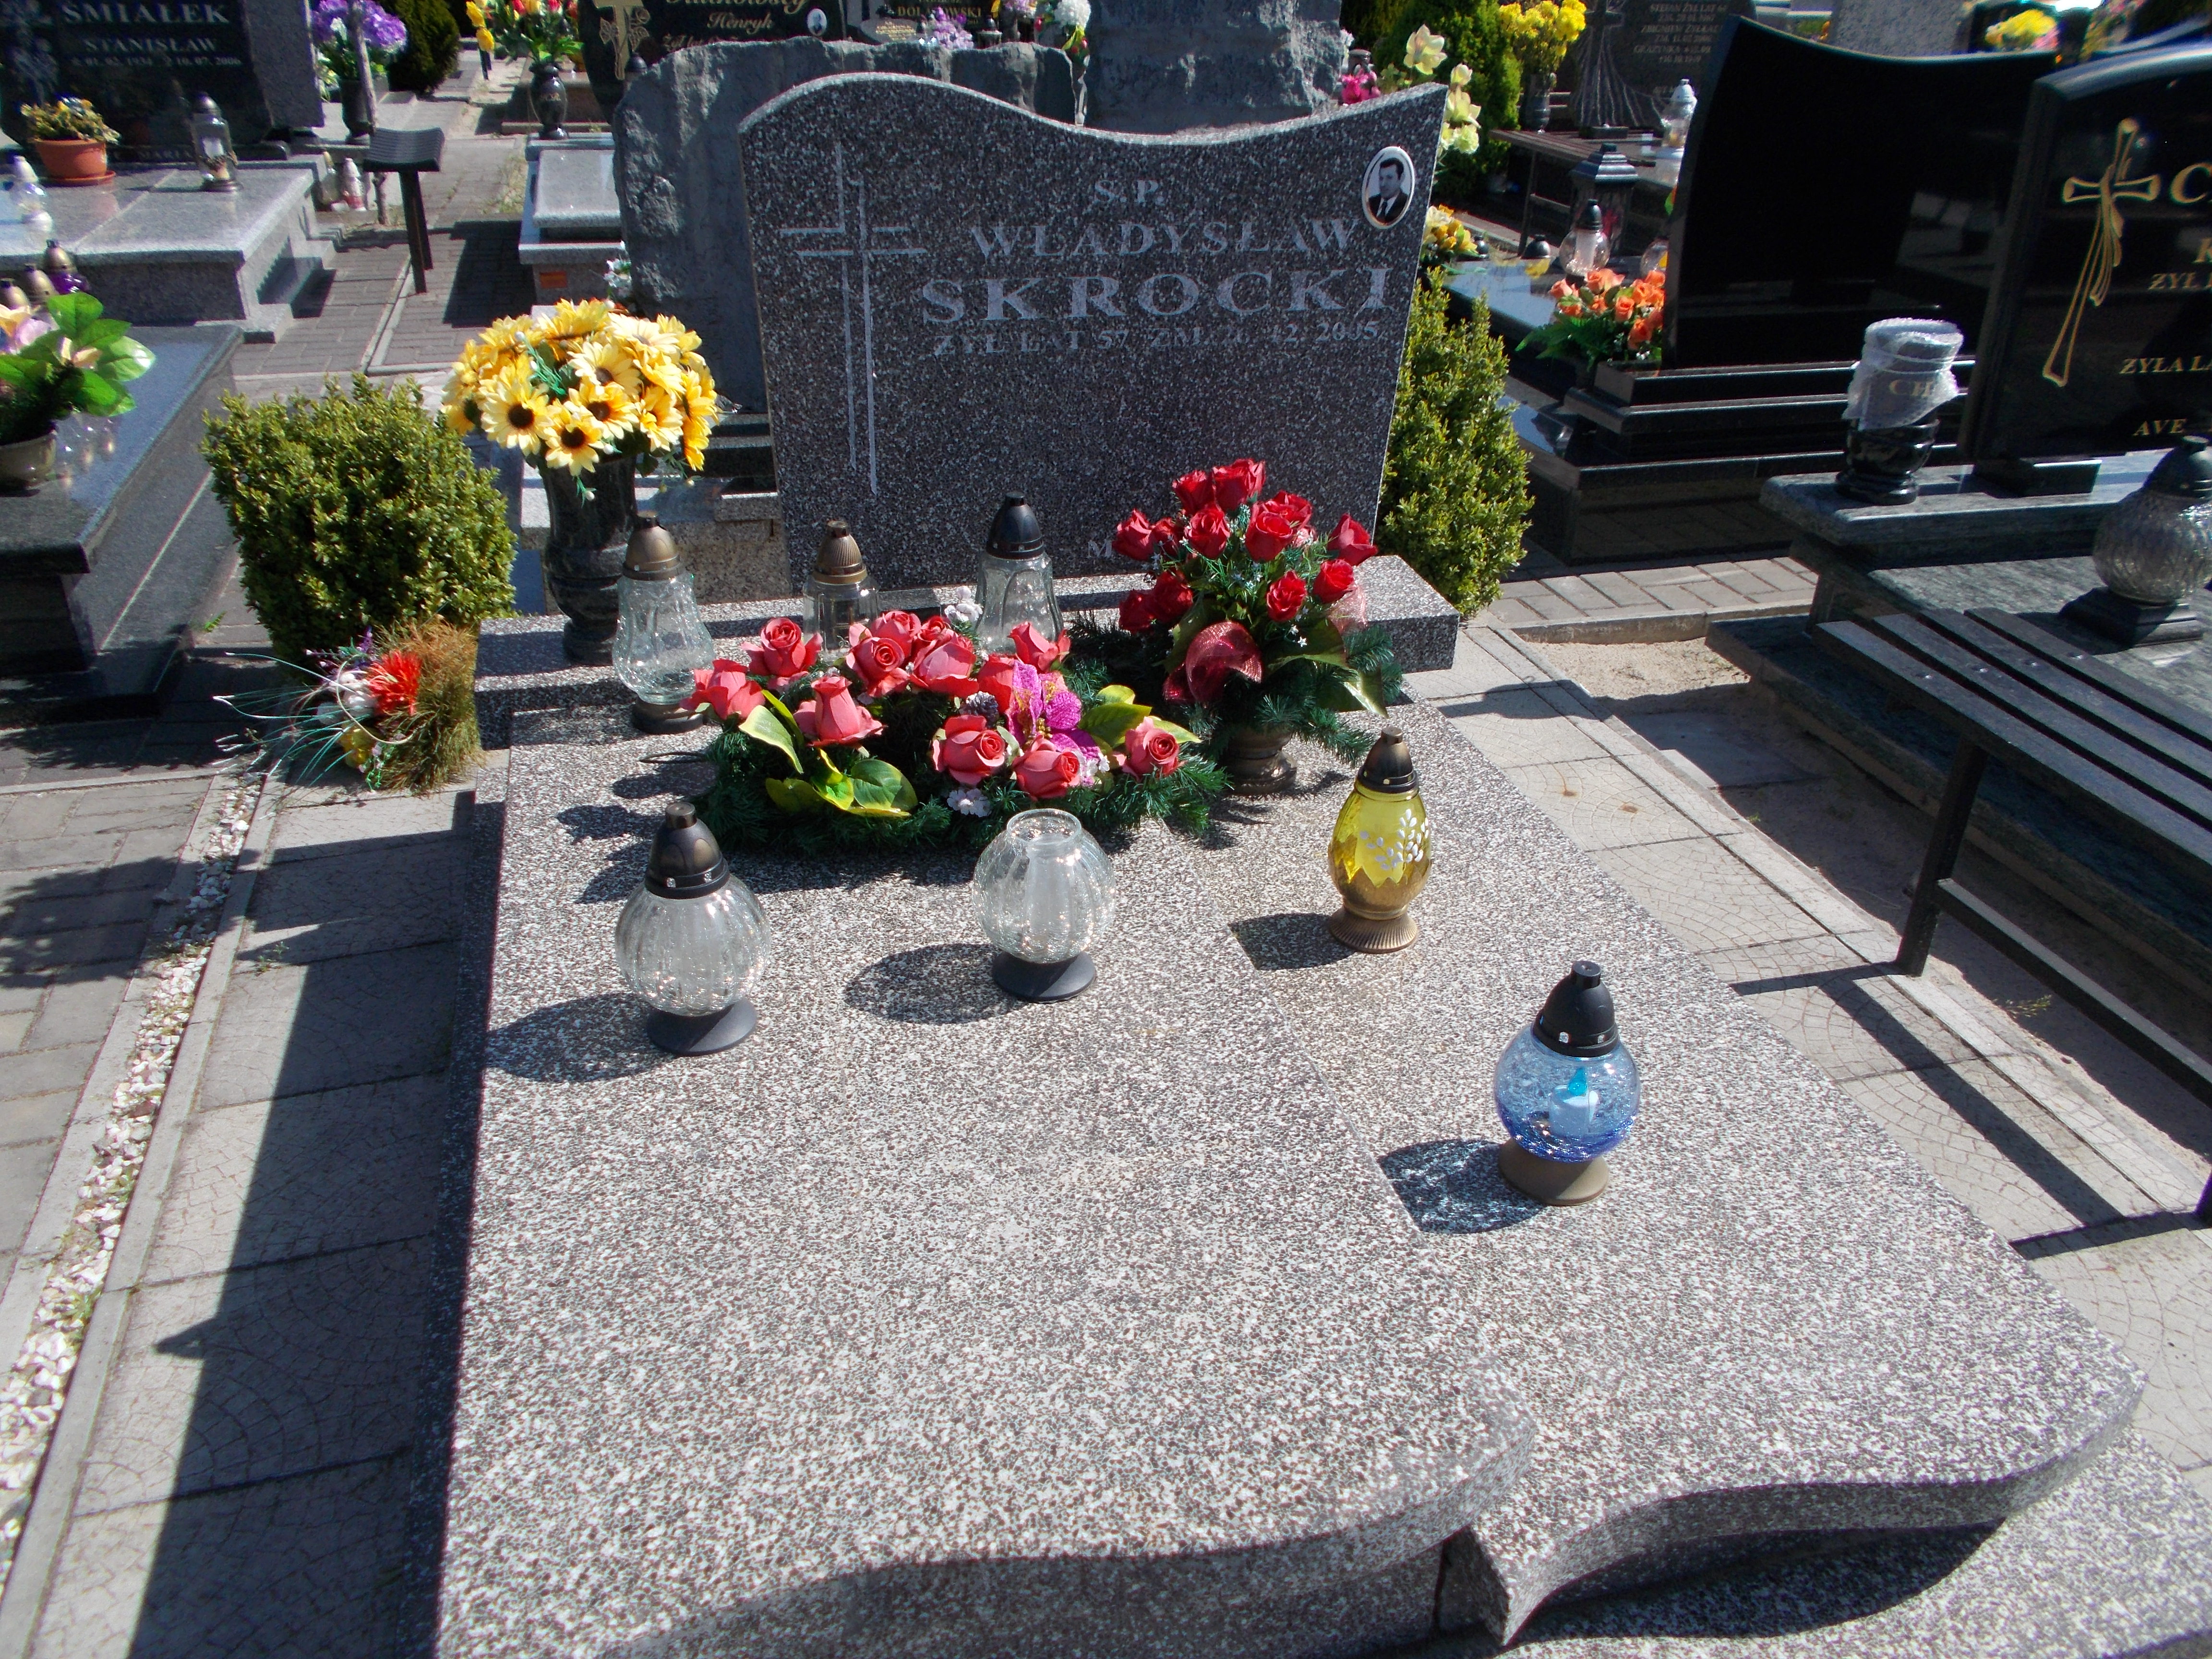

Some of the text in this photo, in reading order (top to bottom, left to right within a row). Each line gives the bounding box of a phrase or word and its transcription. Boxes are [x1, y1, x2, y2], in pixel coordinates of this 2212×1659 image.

[707, 12, 774, 35] Henryk
[923, 267, 1394, 323] SKROCKI
[2132, 418, 2188, 436] AVE
